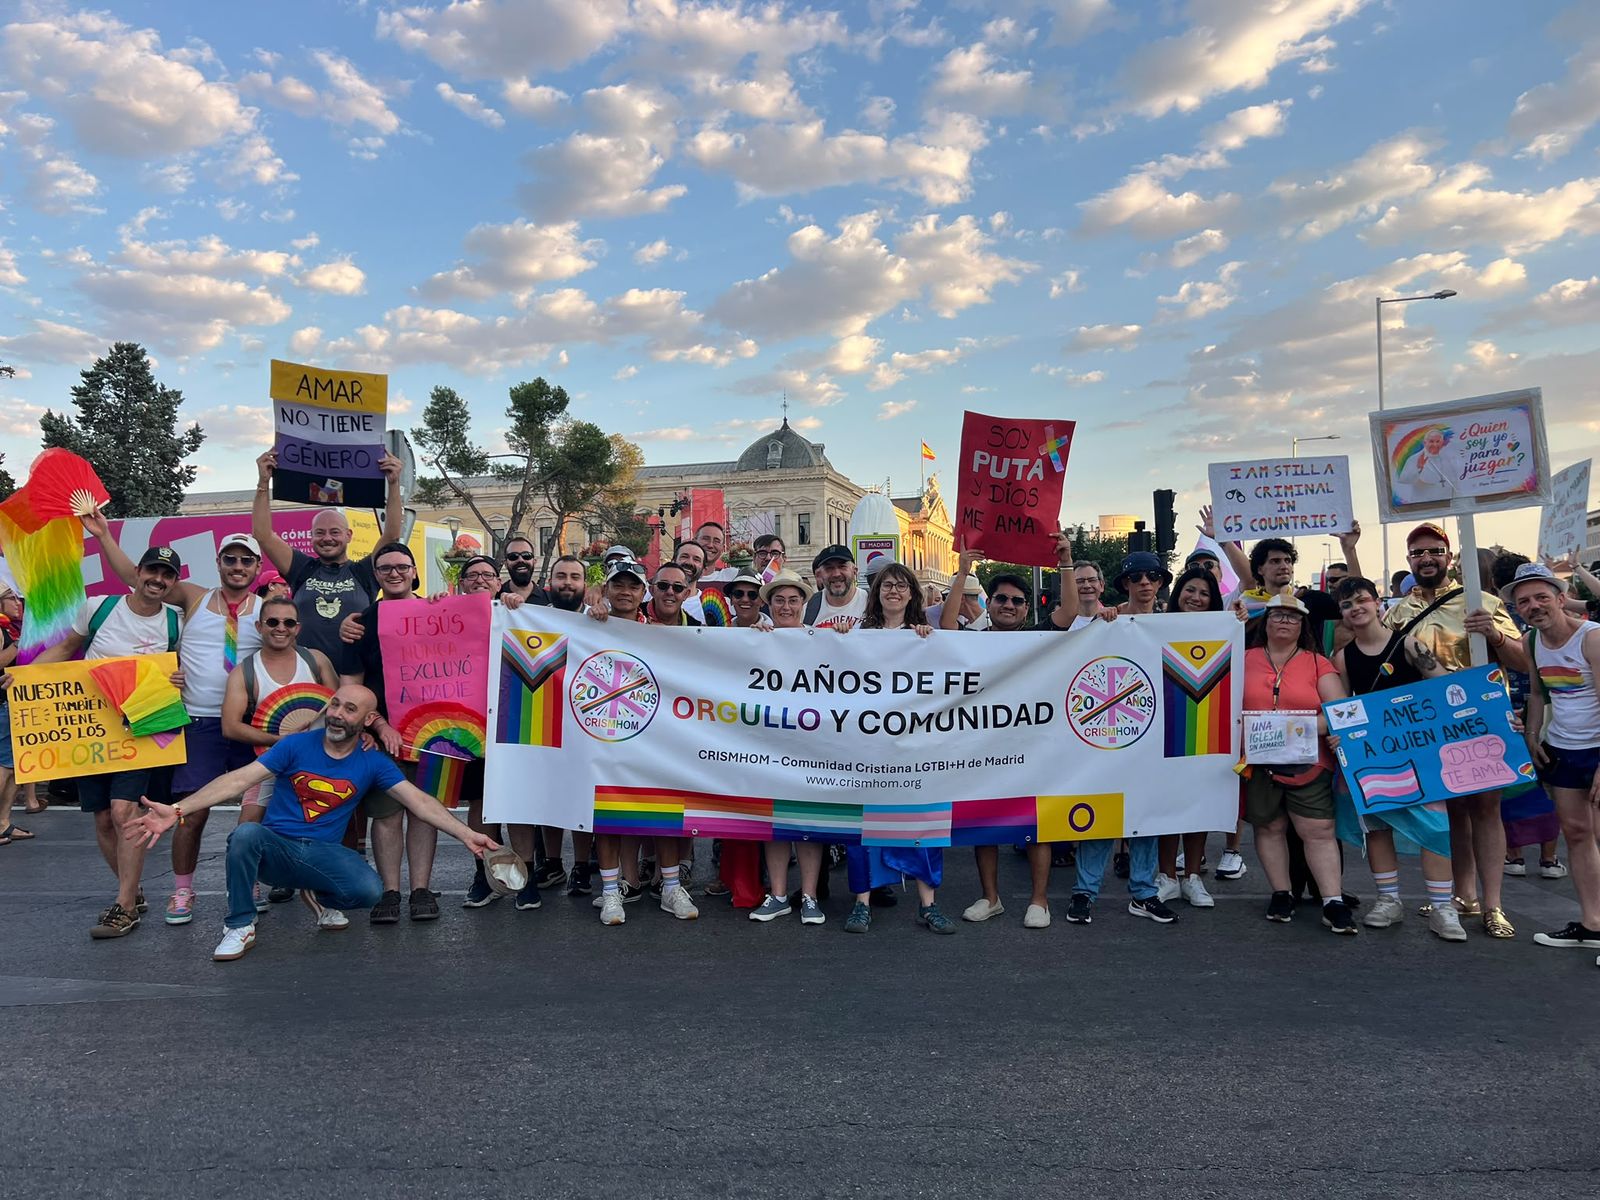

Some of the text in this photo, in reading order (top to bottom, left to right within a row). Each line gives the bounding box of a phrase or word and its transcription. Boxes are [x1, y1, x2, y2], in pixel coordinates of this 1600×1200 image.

[296, 374, 363, 405] AMAR
[281, 407, 309, 426] NO
[987, 425, 1031, 449] SOY
[1465, 433, 1508, 450] soy yo
[283, 443, 371, 469] GÉNERO
[972, 450, 1044, 481] PUTA
[1459, 452, 1525, 480] juzgar?
[1469, 448, 1501, 463] para
[1230, 463, 1334, 480] I AM STILL A
[1254, 482, 1334, 499] CRIMINAL
[1277, 500, 1296, 513] IN
[963, 506, 1035, 535] ME AMA
[1223, 514, 1338, 533] 65 COUNTRIES
[396, 609, 465, 636] JESÚS
[401, 642, 457, 661] NUNCA
[400, 654, 473, 681] EXCLUYÓ
[748, 668, 783, 692] 20
[791, 664, 882, 694] AÑOS
[892, 672, 934, 695] DE
[13, 681, 84, 702] NUESTRA
[400, 681, 473, 703] A NADIE
[574, 683, 657, 705] 20 AÑOS
[1071, 694, 1153, 712] 20 AÑOS
[1383, 698, 1437, 728] AMES
[19, 707, 42, 728] FE
[584, 717, 639, 731] CRISMHOM
[672, 696, 1054, 736] ORGULLO Y COMUNIDAD
[1252, 721, 1272, 732] UNA
[16, 724, 107, 746] TODOS LOS
[1084, 726, 1139, 737] CRISMHOM
[1249, 729, 1283, 743] IGLESIA
[1363, 740, 1378, 759] A
[1442, 717, 1489, 741] AMES
[18, 738, 138, 774] COLORES
[698, 750, 770, 765] CRISMHOM
[781, 756, 852, 771] Comunidad
[856, 763, 912, 774] Cristiana
[915, 760, 965, 772] LGTBI+H
[968, 759, 982, 769] de
[985, 754, 1025, 766] Madrid
[1446, 737, 1504, 766] DIOS
[806, 775, 922, 789] www.crismhom.org
[1443, 762, 1509, 785] TE AMA
